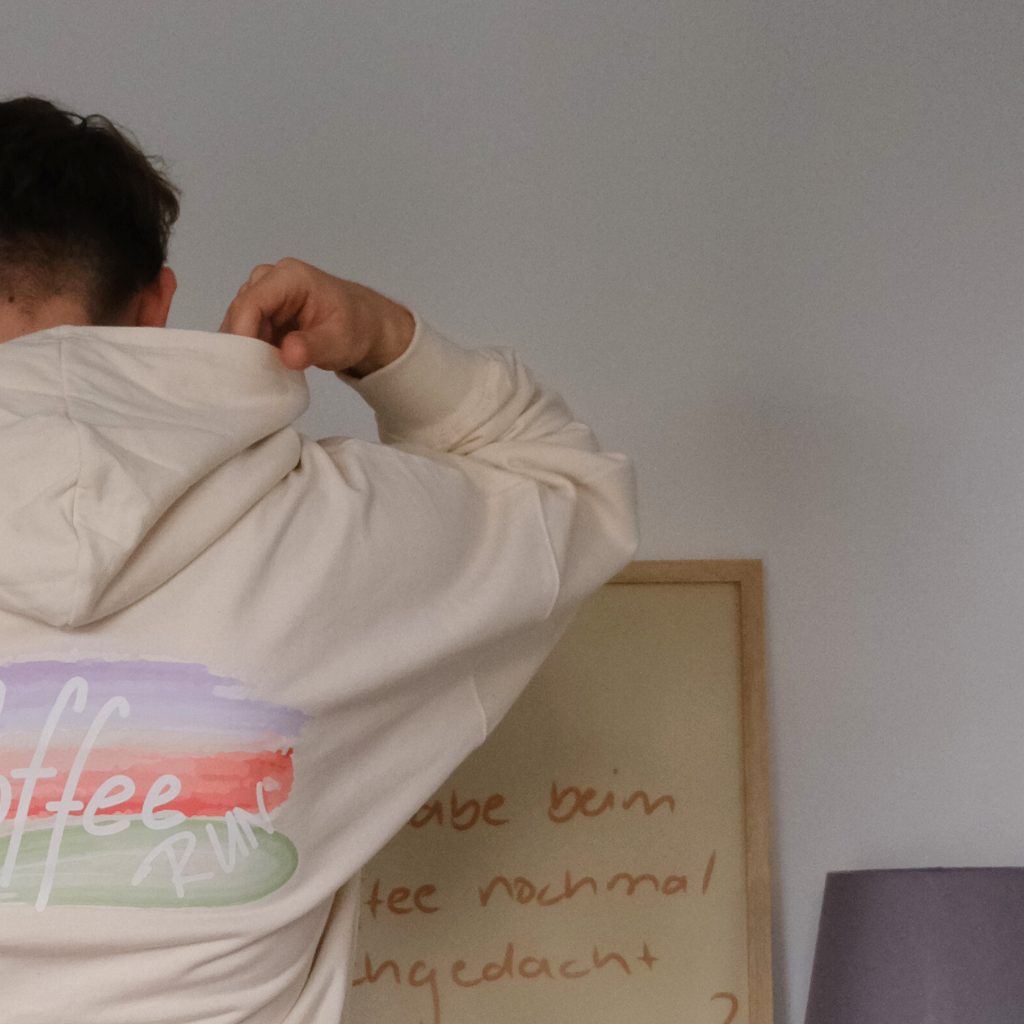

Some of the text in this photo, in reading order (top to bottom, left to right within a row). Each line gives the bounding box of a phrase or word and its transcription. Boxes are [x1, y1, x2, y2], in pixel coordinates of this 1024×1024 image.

[408, 769, 675, 831] abe beim
[131, 781, 274, 898] RUN
[479, 849, 716, 907] nochmal
